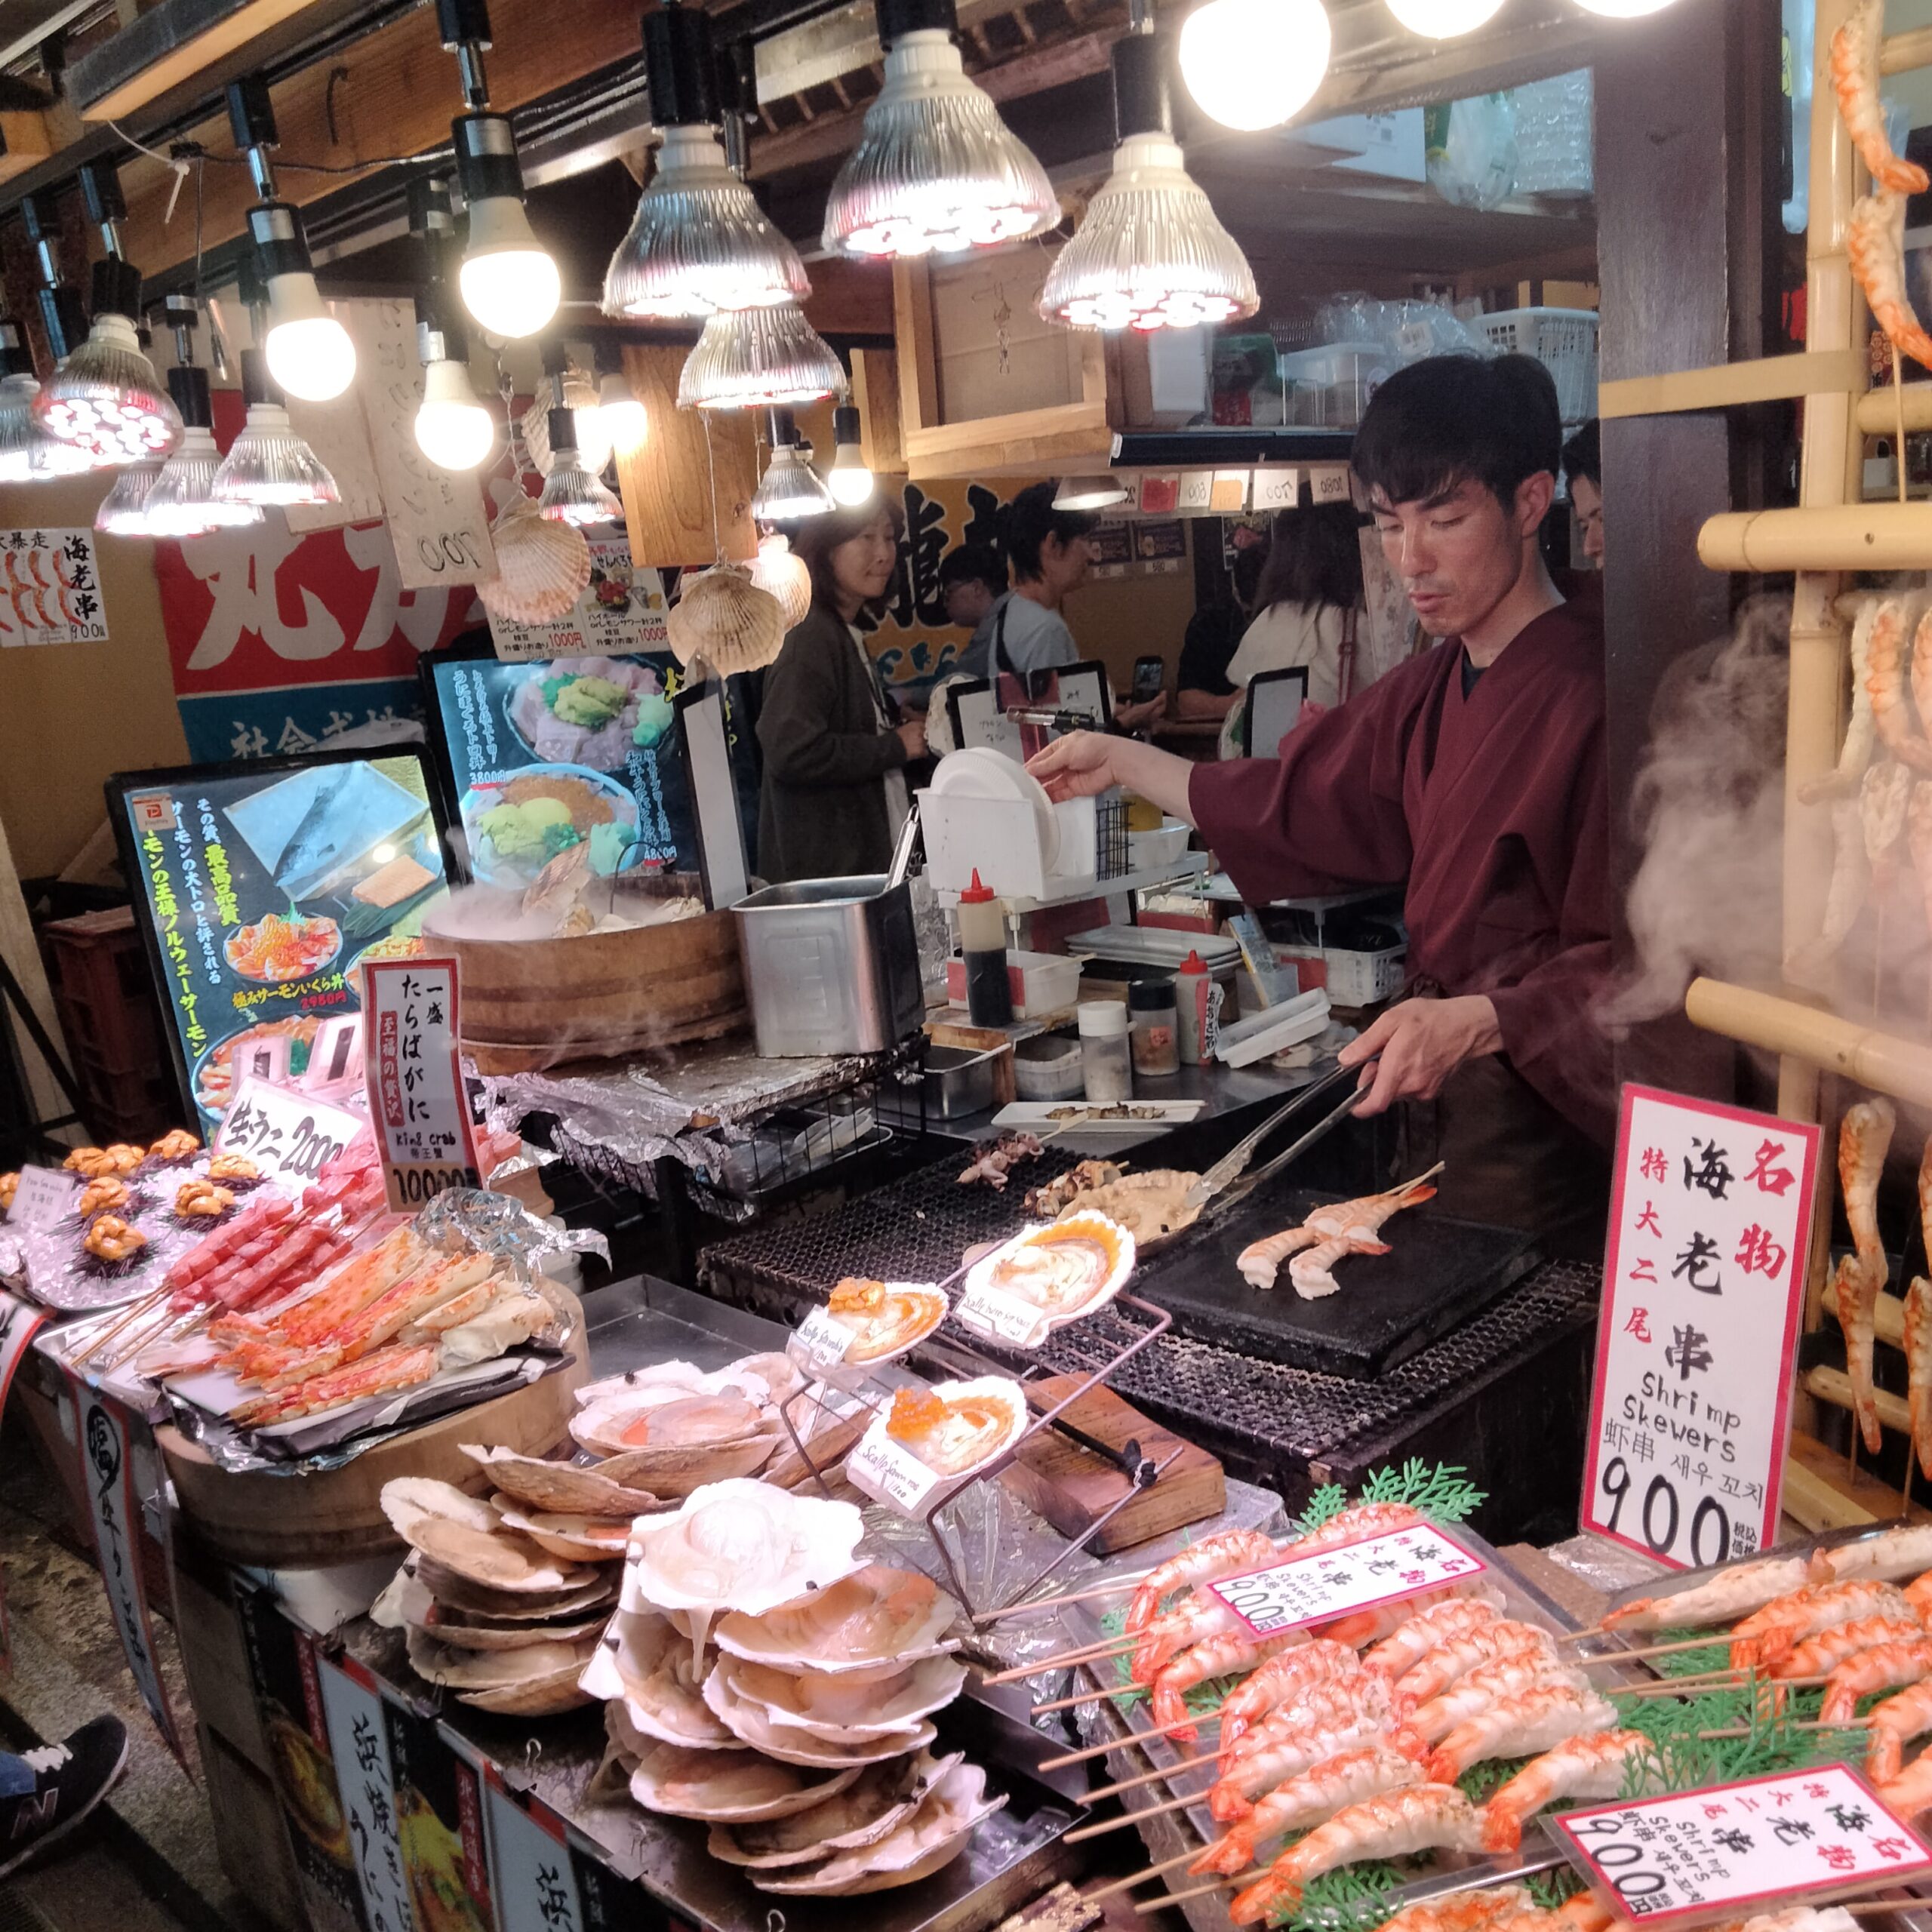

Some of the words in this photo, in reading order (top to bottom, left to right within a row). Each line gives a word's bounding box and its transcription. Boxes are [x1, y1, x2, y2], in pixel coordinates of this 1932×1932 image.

[63, 534, 98, 620] 海老串
[549, 632, 583, 648] 1000円
[469, 769, 506, 785] 3800円
[143, 829, 208, 1058] ーモンの王様ノルウェーサーモン
[426, 985, 444, 1025] 一盛
[401, 974, 430, 1123] たらばがに
[1735, 1139, 1797, 1280] 名物
[1623, 1146, 1669, 1344] 特大二尾
[1665, 1137, 1735, 1380] 海老串
[1623, 1394, 1736, 1463] Skewers
[1641, 1371, 1741, 1434] Shrimp
[1603, 1417, 1655, 1463] 虾串
[1671, 1454, 1713, 1487] 새우
[1602, 1457, 1730, 1568] 900
[1322, 1544, 1443, 1586] 海老串
[1400, 1558, 1468, 1585] 名物
[1618, 1811, 1657, 1841] 虾串
[1700, 1782, 1830, 1820] 特大二尾
[1649, 1816, 1711, 1881] Skewers
[1676, 1821, 1730, 1878] Shrimp
[1712, 1804, 1873, 1854] 海老串
[1817, 1835, 1912, 1870] 名物
